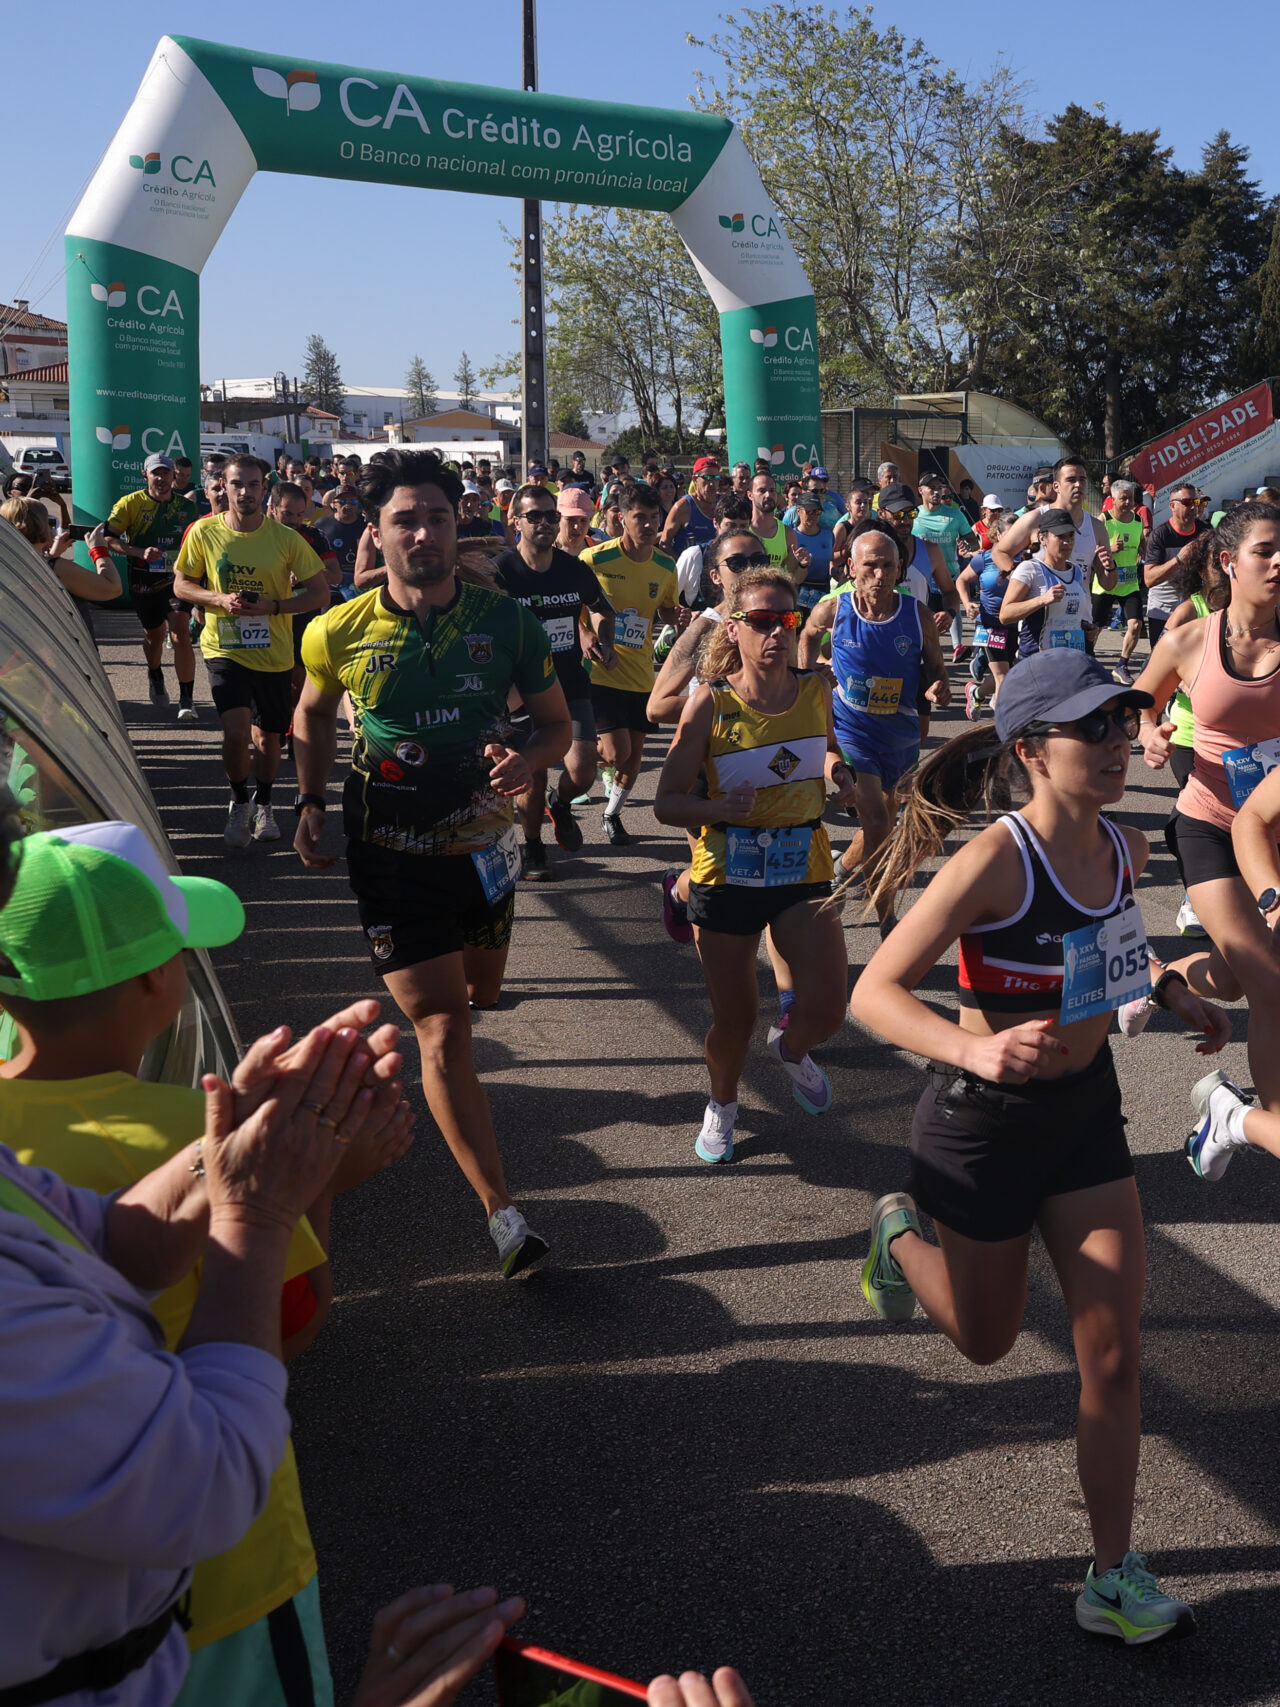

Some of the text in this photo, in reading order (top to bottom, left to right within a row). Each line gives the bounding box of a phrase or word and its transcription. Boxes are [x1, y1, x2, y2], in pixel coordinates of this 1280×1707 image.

[338, 77, 692, 162] CA Crédito Agrícola
[171, 155, 216, 188] CA
[340, 140, 688, 193] O Banco nacional com pronúncia local
[142, 184, 216, 202] Crédito Agrícola
[752, 214, 781, 239] CA
[732, 240, 759, 249] Crédito
[136, 285, 184, 320] CA
[107, 318, 185, 336] Crédito Agrícola
[785, 326, 814, 352] CA
[763, 356, 792, 365] Crédito
[96, 388, 186, 404] www.creditoagricola.pt
[141, 427, 187, 457] CA
[1149, 400, 1259, 474] FIDELIDADE
[792, 443, 821, 467] CA
[112, 460, 146, 471] Crédit
[986, 464, 1020, 472] ORGULHO
[986, 472, 1034, 480] PATROCINAR
[242, 628, 270, 640] 072
[549, 629, 574, 643] 076
[626, 628, 645, 640] 074
[365, 653, 398, 674] JR
[871, 691, 899, 705] 446
[415, 707, 460, 726] HJM
[767, 849, 808, 870] 452
[731, 867, 760, 877] VET. A
[1080, 943, 1096, 955] XXV
[1108, 942, 1150, 983] 053
[1003, 974, 1041, 991] The
[1067, 987, 1104, 1009] ELITES
